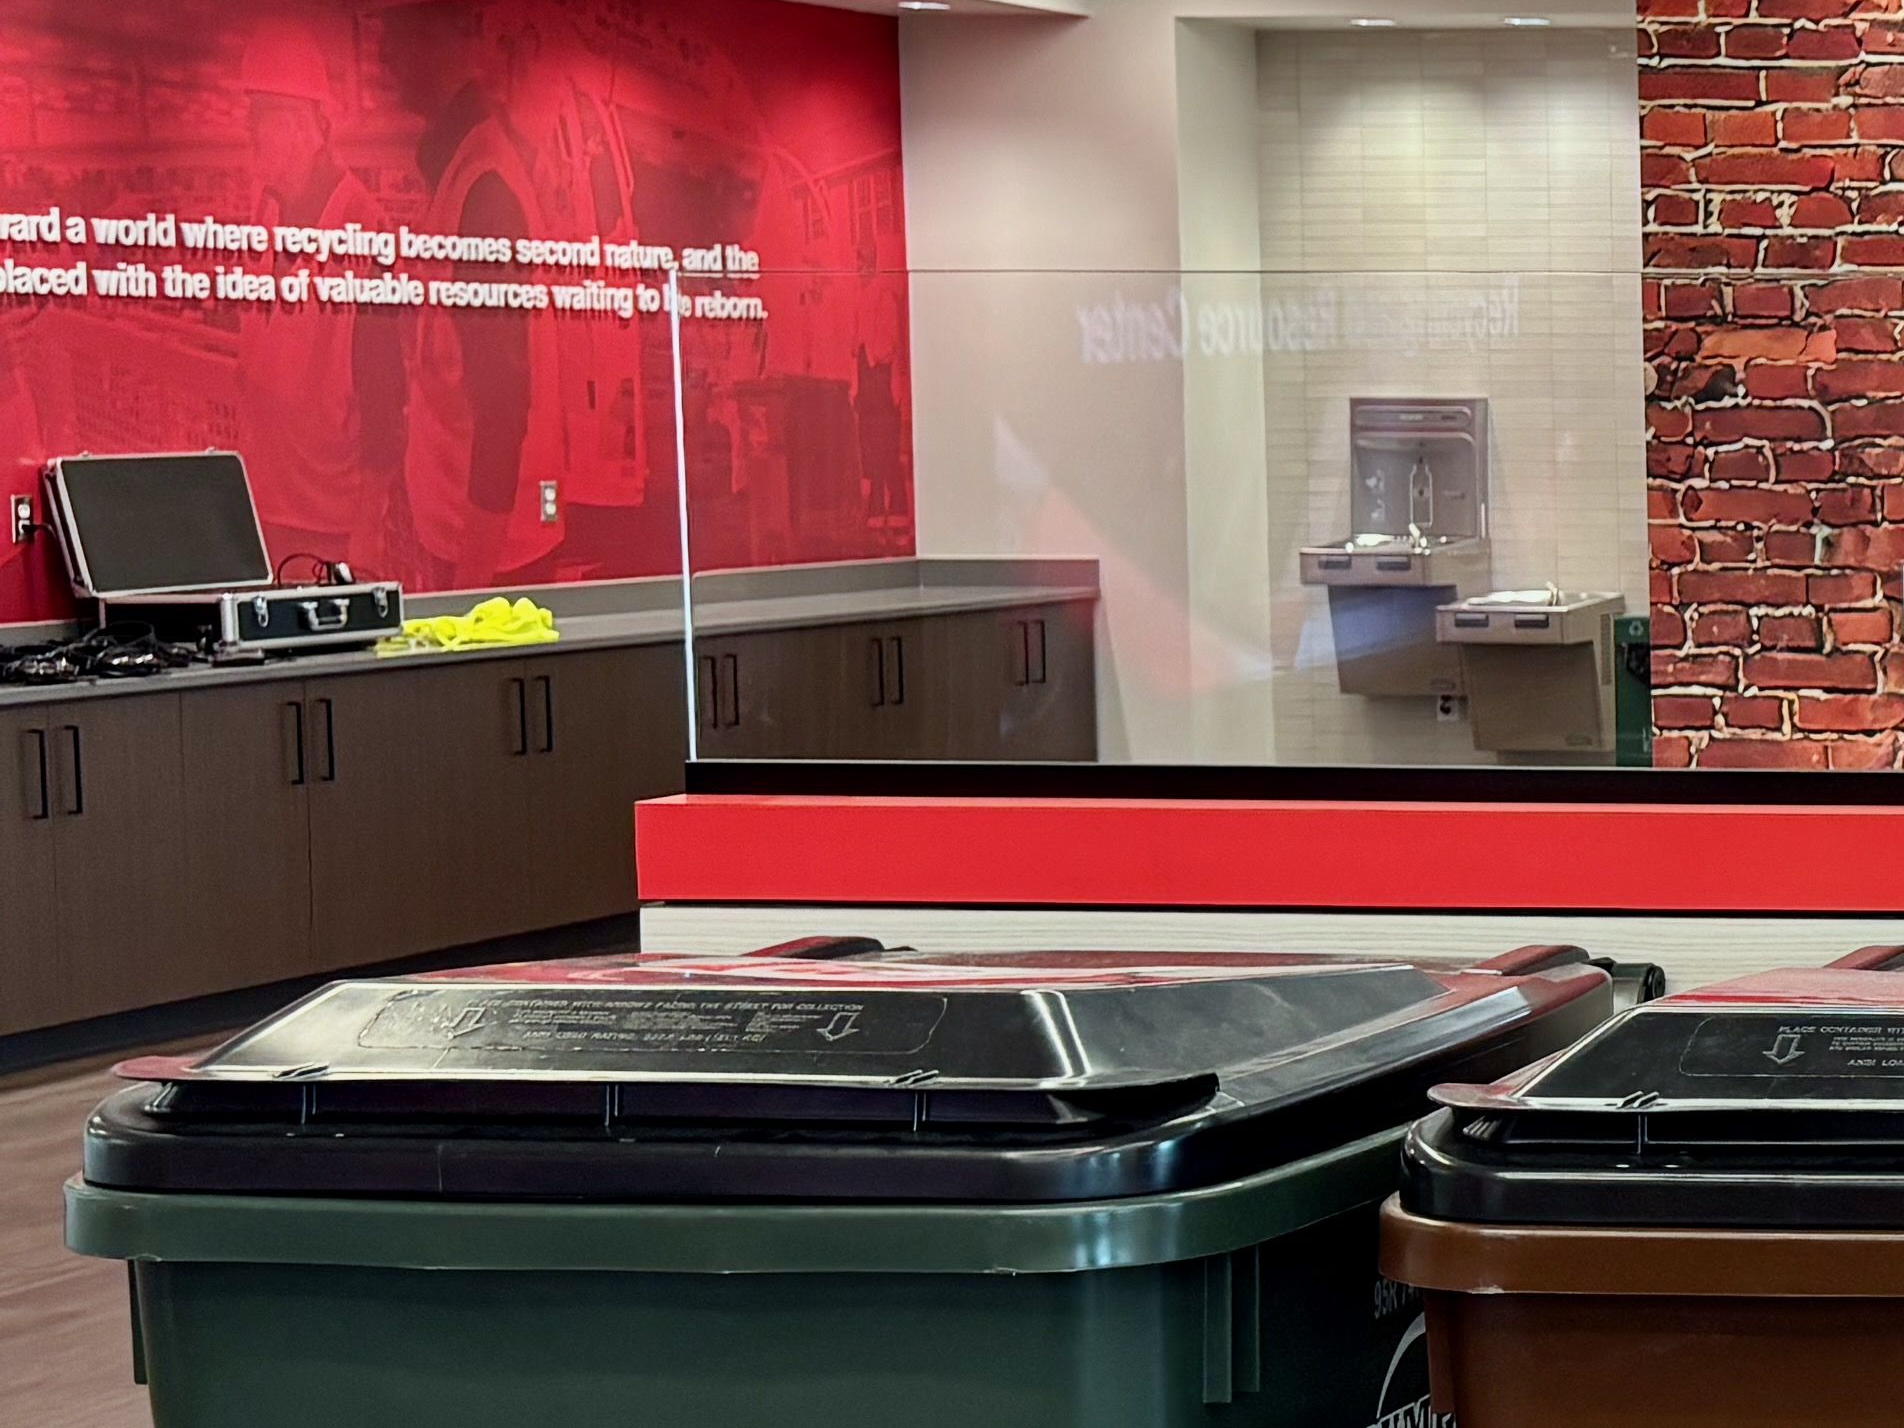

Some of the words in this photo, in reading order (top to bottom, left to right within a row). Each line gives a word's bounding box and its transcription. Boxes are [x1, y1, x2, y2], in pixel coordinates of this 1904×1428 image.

[65, 216, 87, 245] a
[90, 213, 176, 249] world
[180, 216, 268, 253] where
[273, 223, 397, 265] recycling
[399, 225, 513, 263] becomes
[515, 235, 600, 267] second
[604, 241, 679, 271] nature,
[681, 244, 722, 272] and
[725, 244, 760, 272] the
[91, 262, 157, 299] with
[161, 264, 211, 300] the
[216, 265, 277, 302] idea
[280, 268, 311, 303] of
[312, 270, 425, 306] valuable
[428, 280, 550, 310] resources
[550, 279, 636, 319] waiting
[635, 284, 661, 314] to
[693, 290, 769, 321] reborn.
